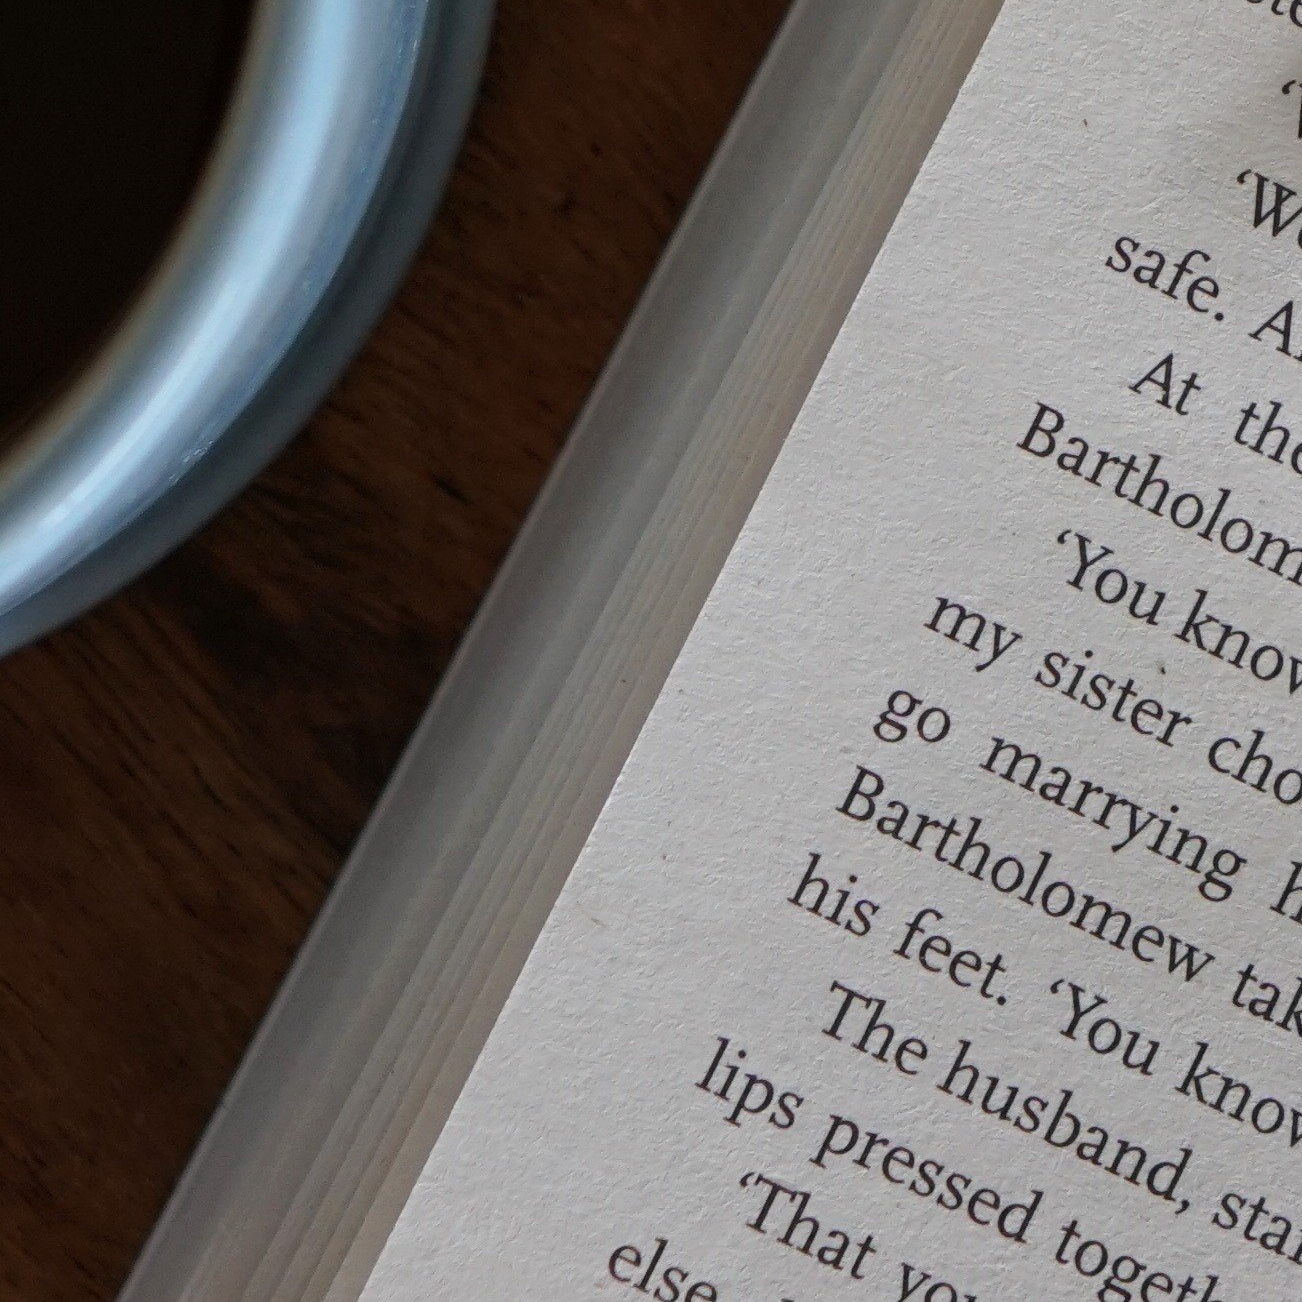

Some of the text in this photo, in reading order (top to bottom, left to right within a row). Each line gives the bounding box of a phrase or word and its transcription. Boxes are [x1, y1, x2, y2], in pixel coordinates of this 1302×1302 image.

[1105, 236, 1224, 322] safe.
[1128, 353, 1201, 416] At
[924, 597, 1023, 673] my
[1034, 652, 1193, 747] sister
[835, 765, 1215, 982] Bartholomew
[695, 1036, 1044, 1244] lips pressed
[822, 980, 1193, 1216] The husband,
